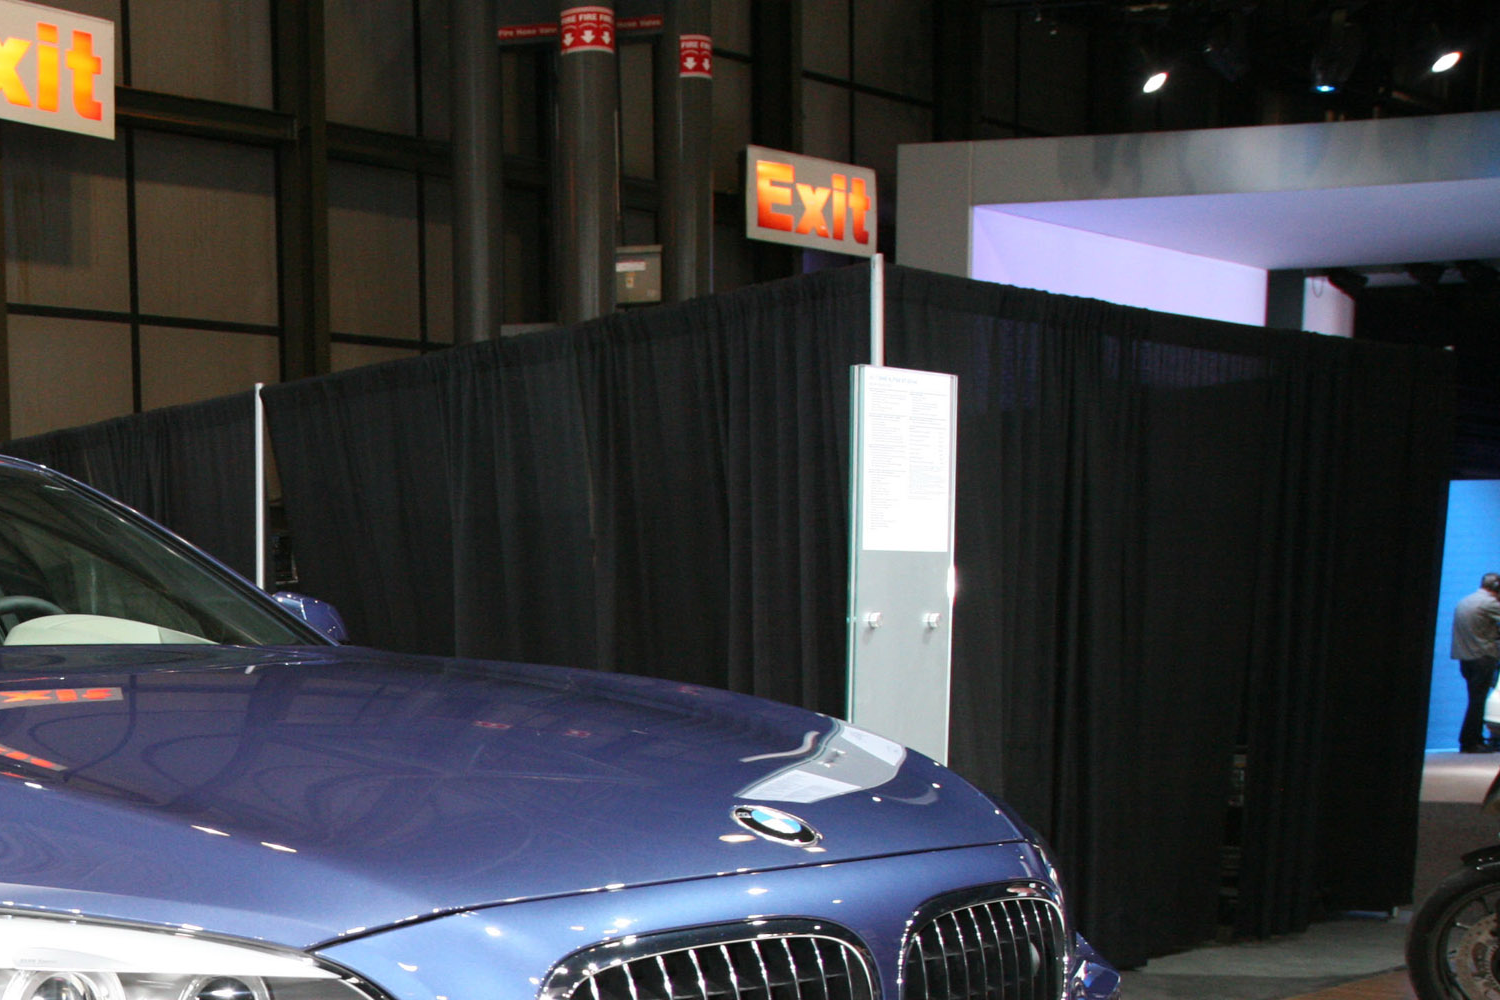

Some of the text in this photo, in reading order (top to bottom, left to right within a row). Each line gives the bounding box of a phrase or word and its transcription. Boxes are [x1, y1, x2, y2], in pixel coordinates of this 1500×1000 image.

[578, 12, 598, 22] FIRE
[680, 41, 698, 49] FIRE
[756, 160, 870, 245] Exit
